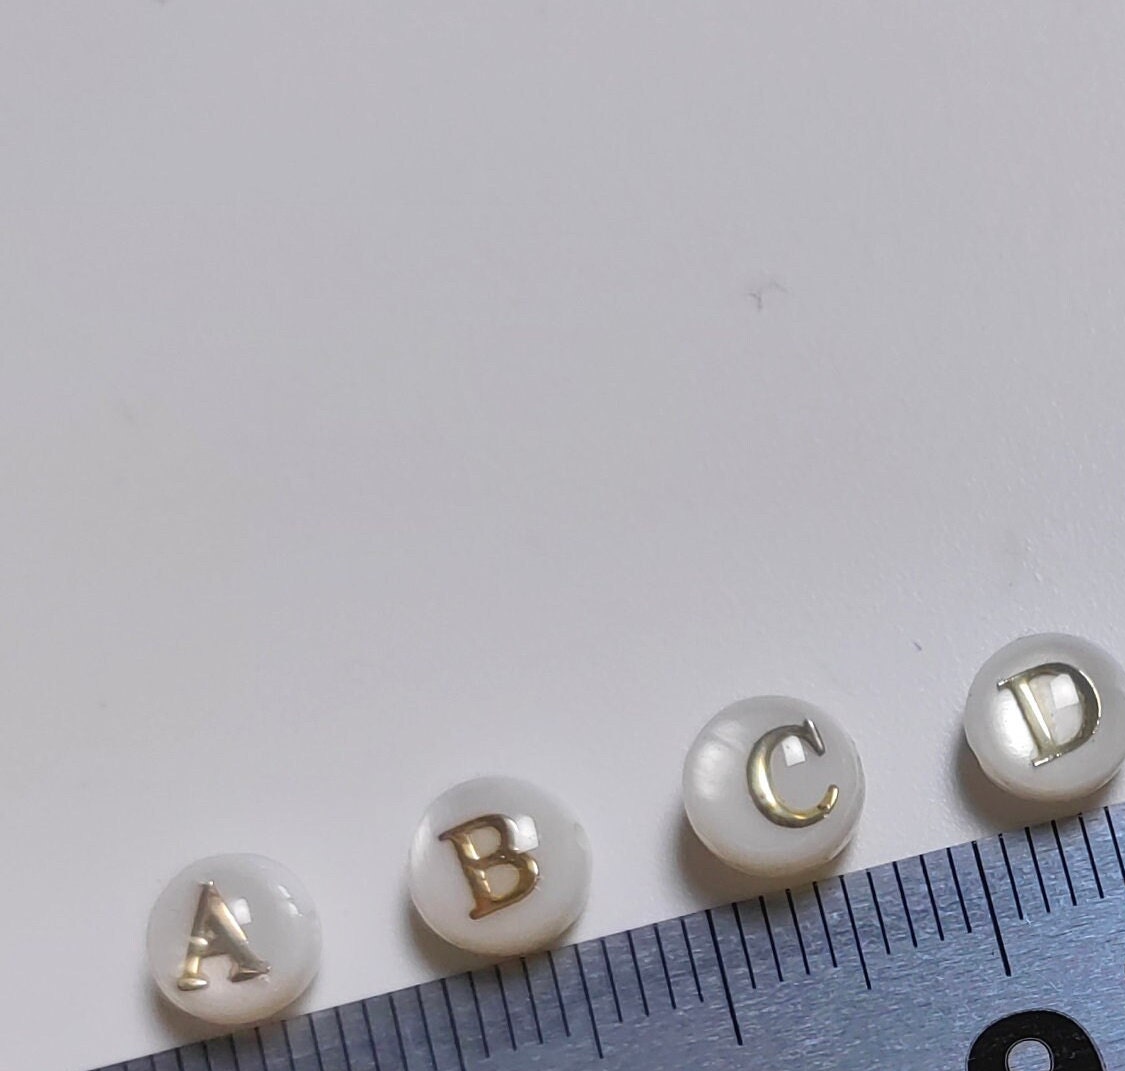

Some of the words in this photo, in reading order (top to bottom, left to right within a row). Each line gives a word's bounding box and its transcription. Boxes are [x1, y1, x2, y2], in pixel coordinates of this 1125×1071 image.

[997, 662, 1102, 767] D
[746, 719, 838, 828] C
[439, 814, 541, 919] B
[176, 881, 270, 991] A
